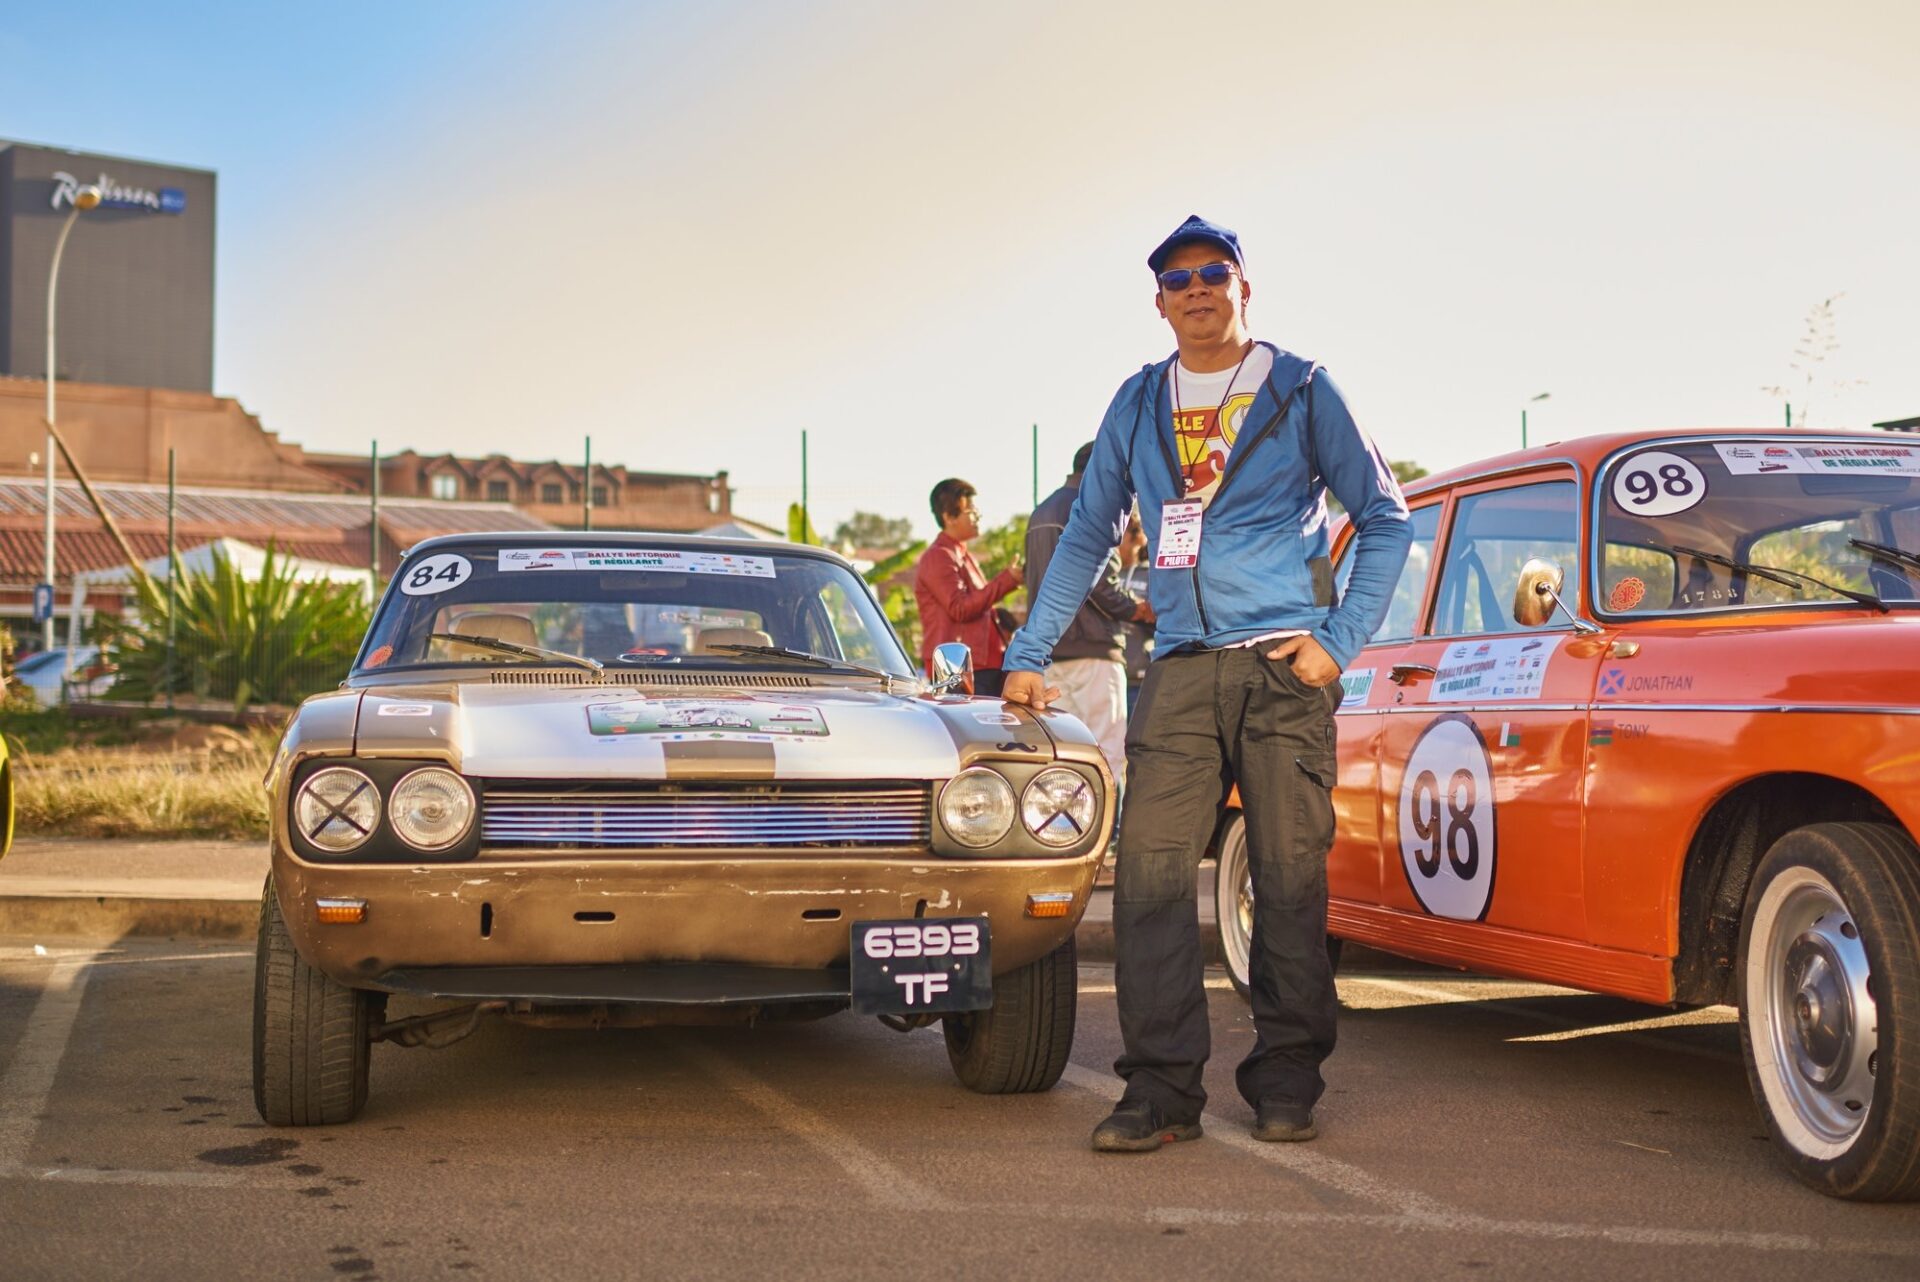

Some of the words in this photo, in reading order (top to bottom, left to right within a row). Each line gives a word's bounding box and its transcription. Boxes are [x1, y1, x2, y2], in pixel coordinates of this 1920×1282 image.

[1624, 464, 1693, 505] 98
[410, 561, 460, 588] 84
[1164, 556, 1190, 566] PILOTE
[37, 588, 49, 618] P
[1626, 676, 1693, 691] JONATHAN
[1617, 724, 1649, 739] TONY
[1412, 768, 1479, 881] 98
[864, 925, 980, 958] 6393
[895, 973, 949, 1005] TF
